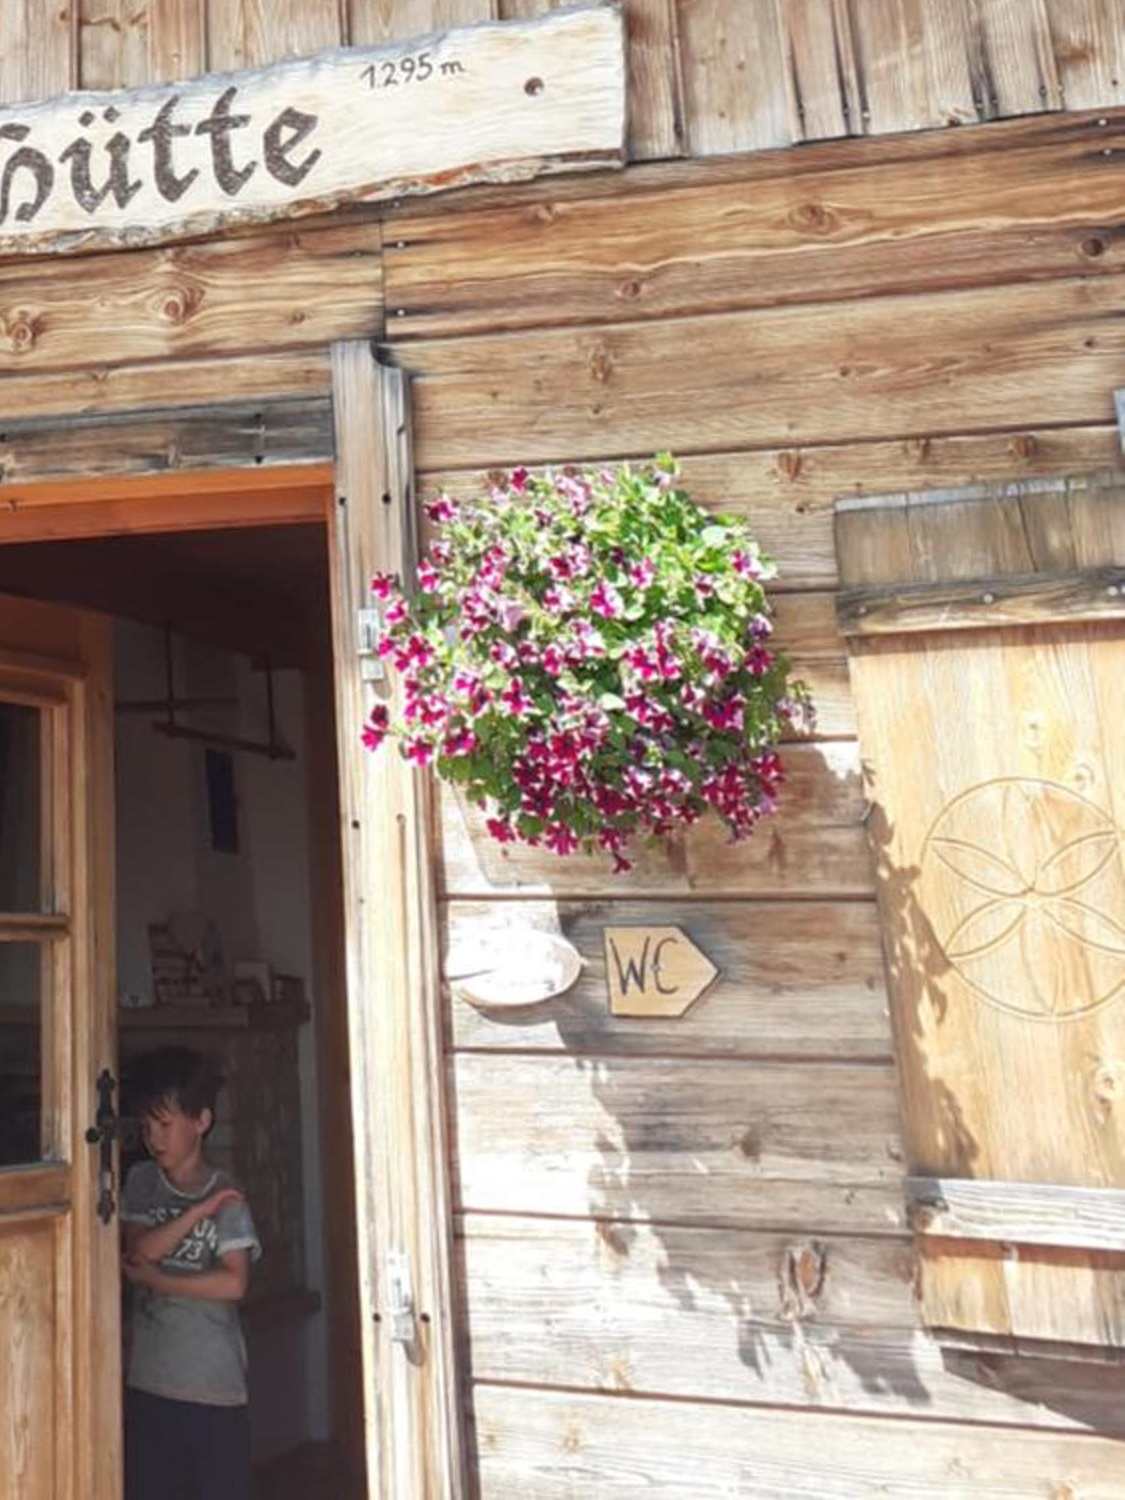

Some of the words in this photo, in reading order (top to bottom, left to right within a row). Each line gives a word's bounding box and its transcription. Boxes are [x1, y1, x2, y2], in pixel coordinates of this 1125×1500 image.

[359, 53, 433, 89] 1295
[439, 60, 467, 76] m
[608, 935, 679, 996] WC
